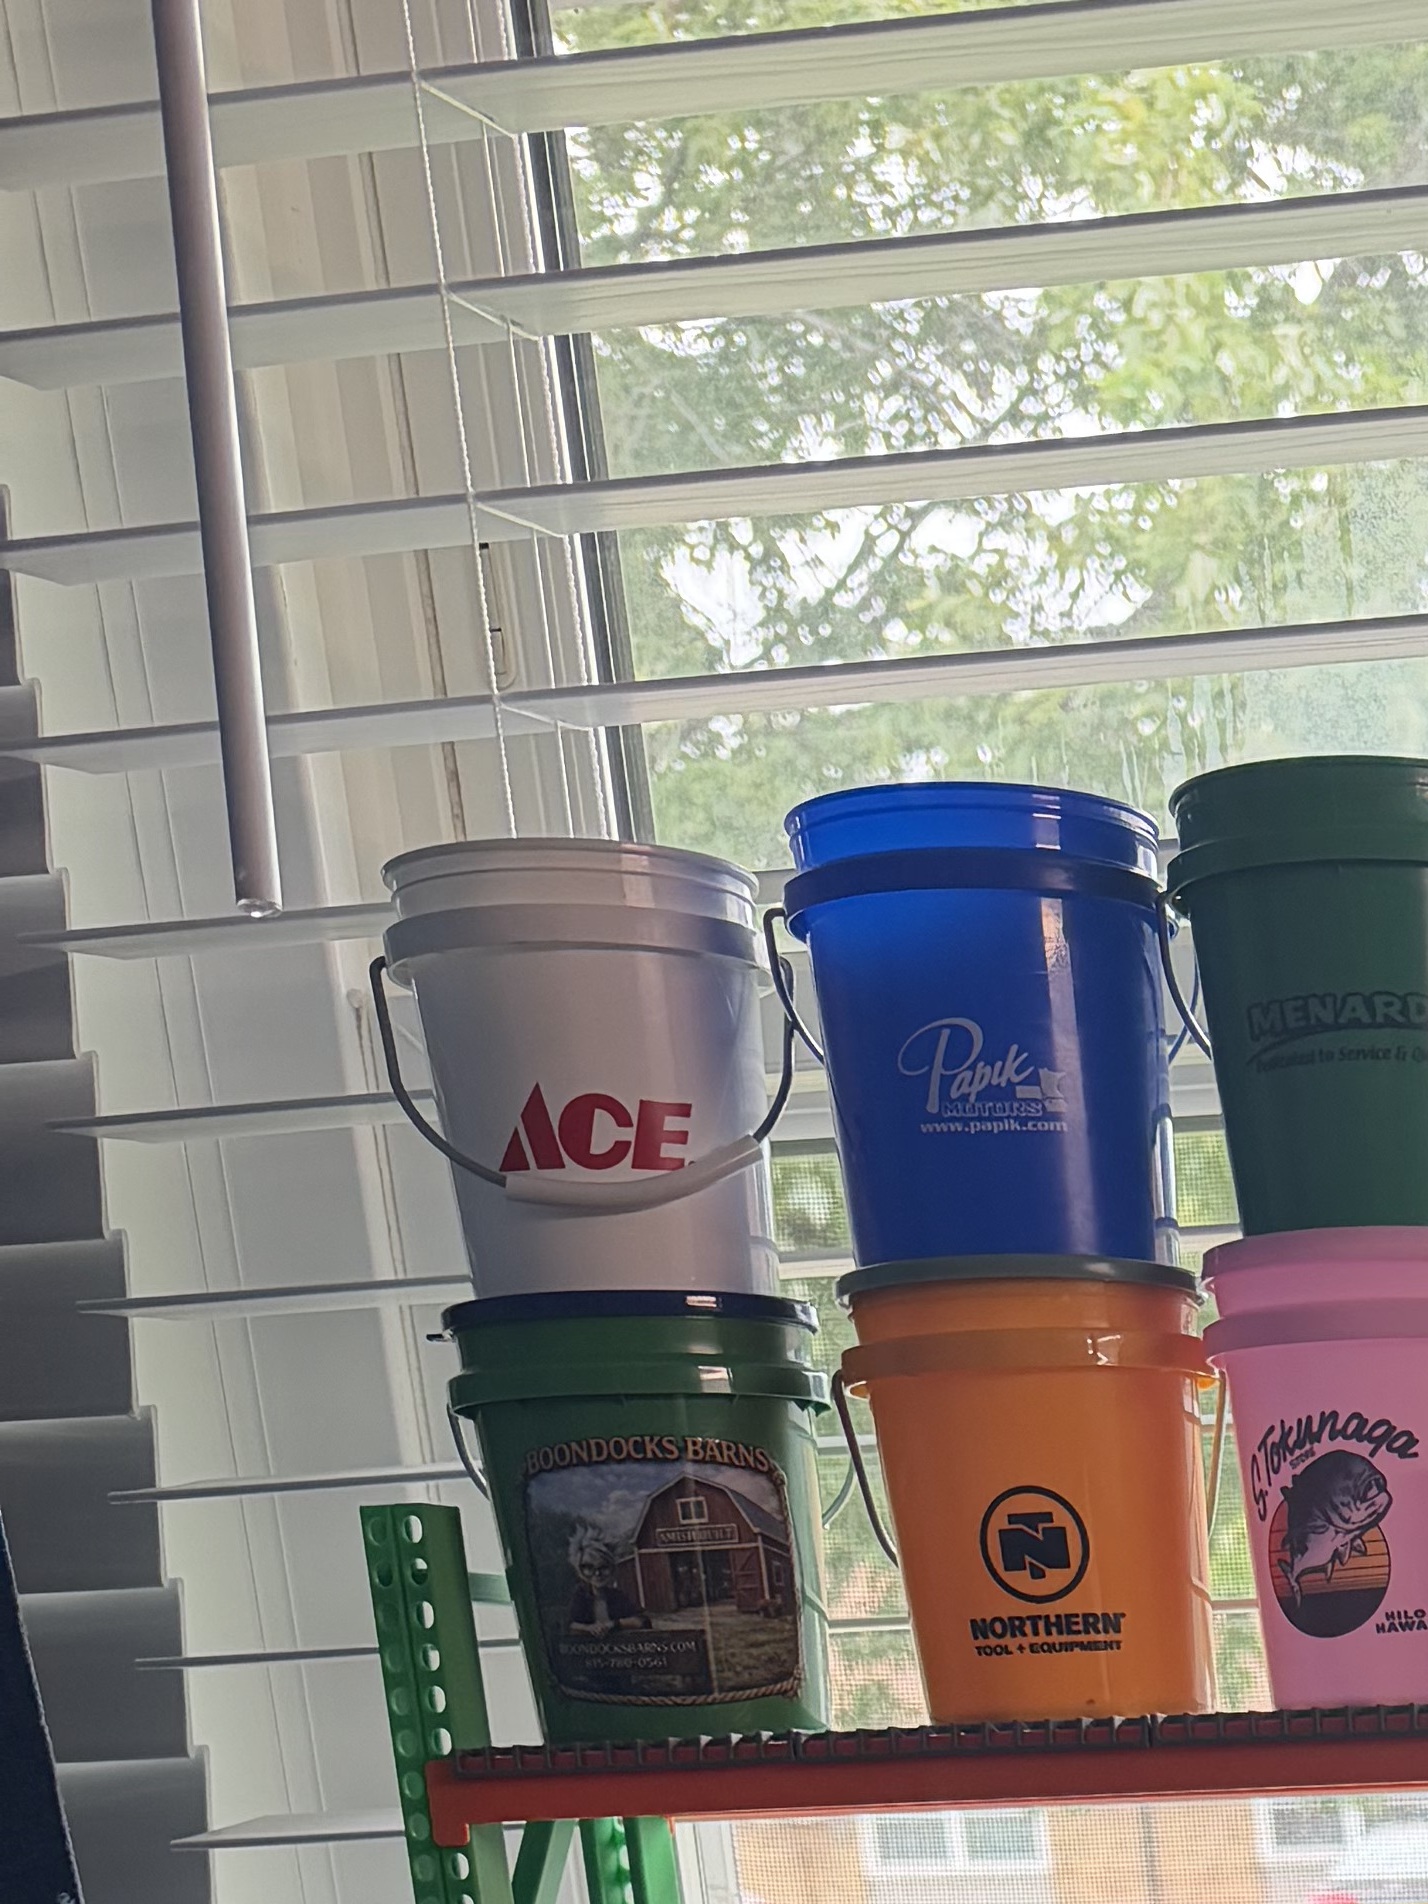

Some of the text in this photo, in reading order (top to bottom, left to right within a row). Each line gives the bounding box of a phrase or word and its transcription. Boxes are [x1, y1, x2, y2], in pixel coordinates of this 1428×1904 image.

[897, 1018, 1029, 1112] Papik
[1338, 1046, 1393, 1062] Service
[941, 1099, 1043, 1121] MOTORS
[500, 1081, 693, 1173] ACE
[919, 1117, 1068, 1137] www.papik.com
[526, 1435, 769, 1474] BOONDOCKS BARNS
[1257, 1410, 1420, 1488] Tokunaga
[969, 1612, 1123, 1642] NORTHERN
[1385, 1608, 1427, 1622] HILO
[976, 1644, 1014, 1657] TOOL
[1029, 1641, 1123, 1655] EQUIPMENT
